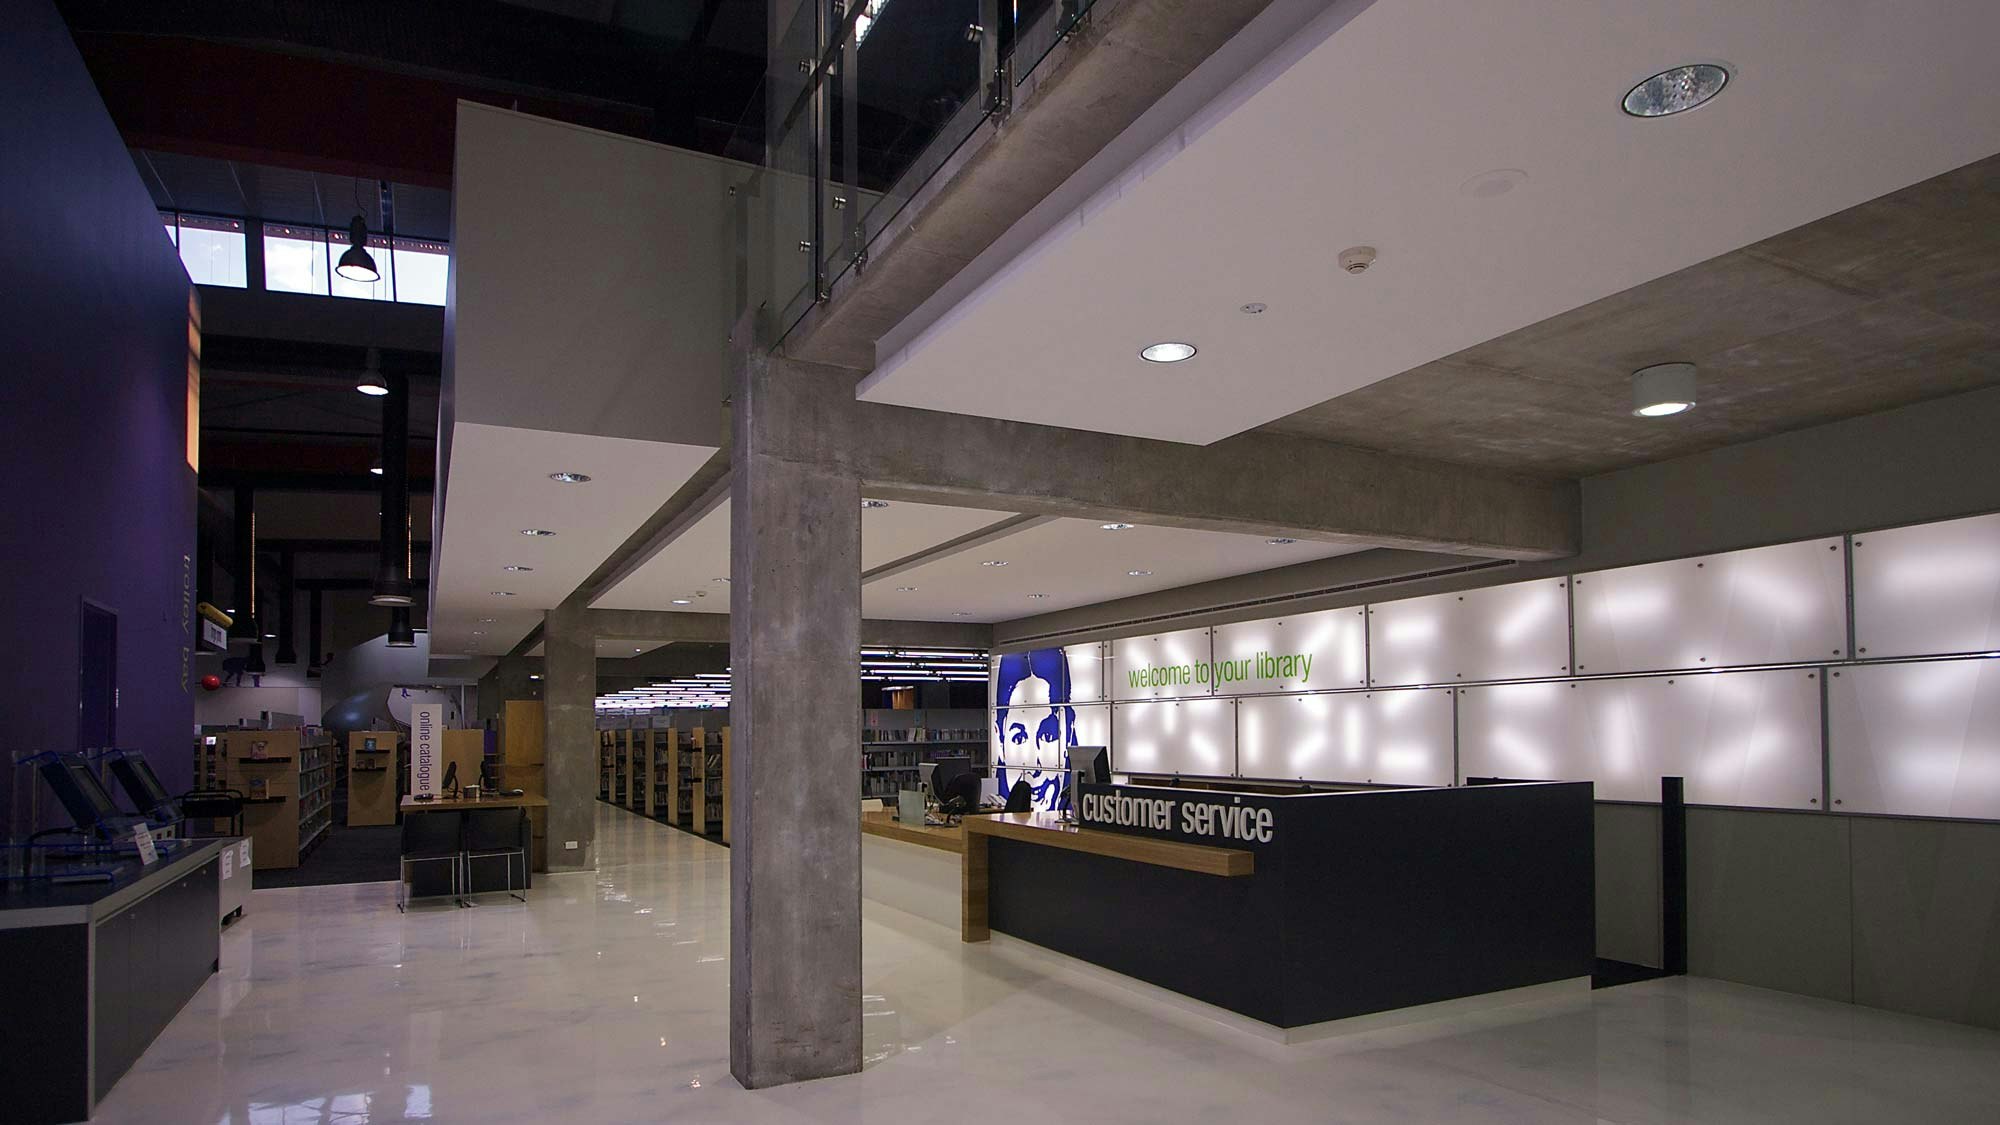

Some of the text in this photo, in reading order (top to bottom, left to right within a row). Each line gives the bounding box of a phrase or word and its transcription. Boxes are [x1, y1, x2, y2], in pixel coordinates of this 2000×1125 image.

[181, 554, 191, 694] trolley bay
[1128, 651, 1313, 688] welcome to your library
[416, 711, 433, 791] online catalogue
[1082, 789, 1274, 843] customer service
